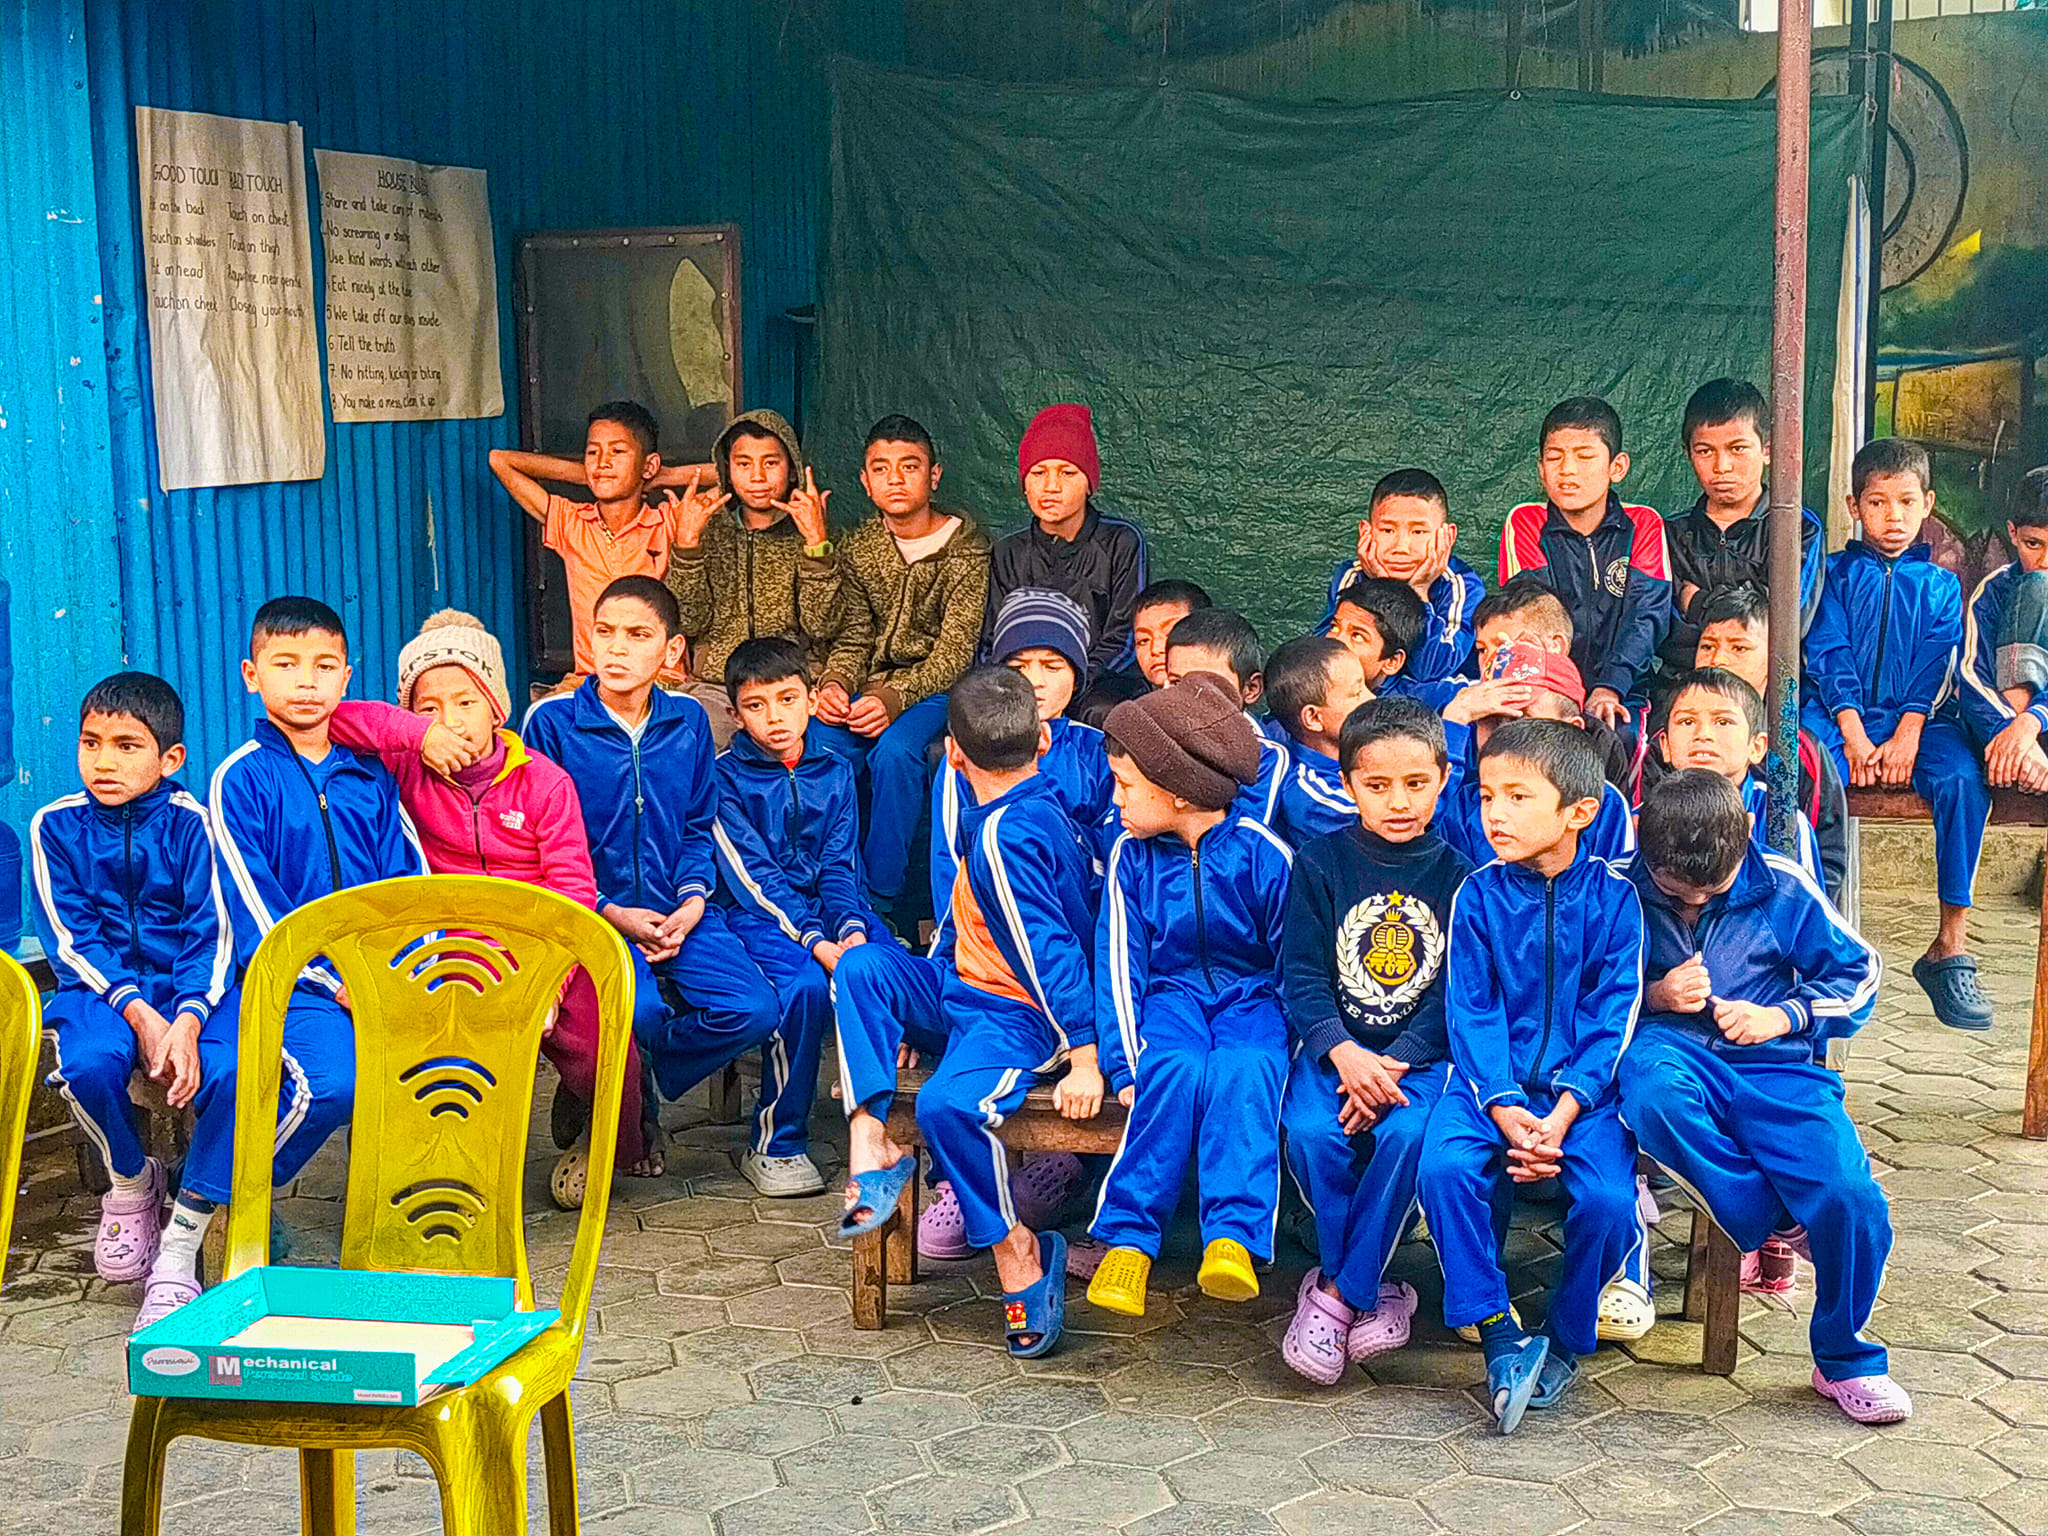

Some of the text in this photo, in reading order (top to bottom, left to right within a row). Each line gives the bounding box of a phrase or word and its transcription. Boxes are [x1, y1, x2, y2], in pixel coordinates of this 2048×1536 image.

[153, 164, 186, 184] GOOD
[246, 174, 284, 194] TOUCH
[352, 196, 366, 211] and
[251, 212, 265, 223] on
[176, 261, 203, 278] head
[373, 307, 386, 324] off
[338, 335, 355, 351] Tell
[358, 335, 372, 352] the
[375, 336, 396, 353] truth
[341, 364, 353, 380] No
[340, 393, 355, 409] You
[360, 394, 376, 409] make
[216, 1356, 337, 1376] Mechanical
